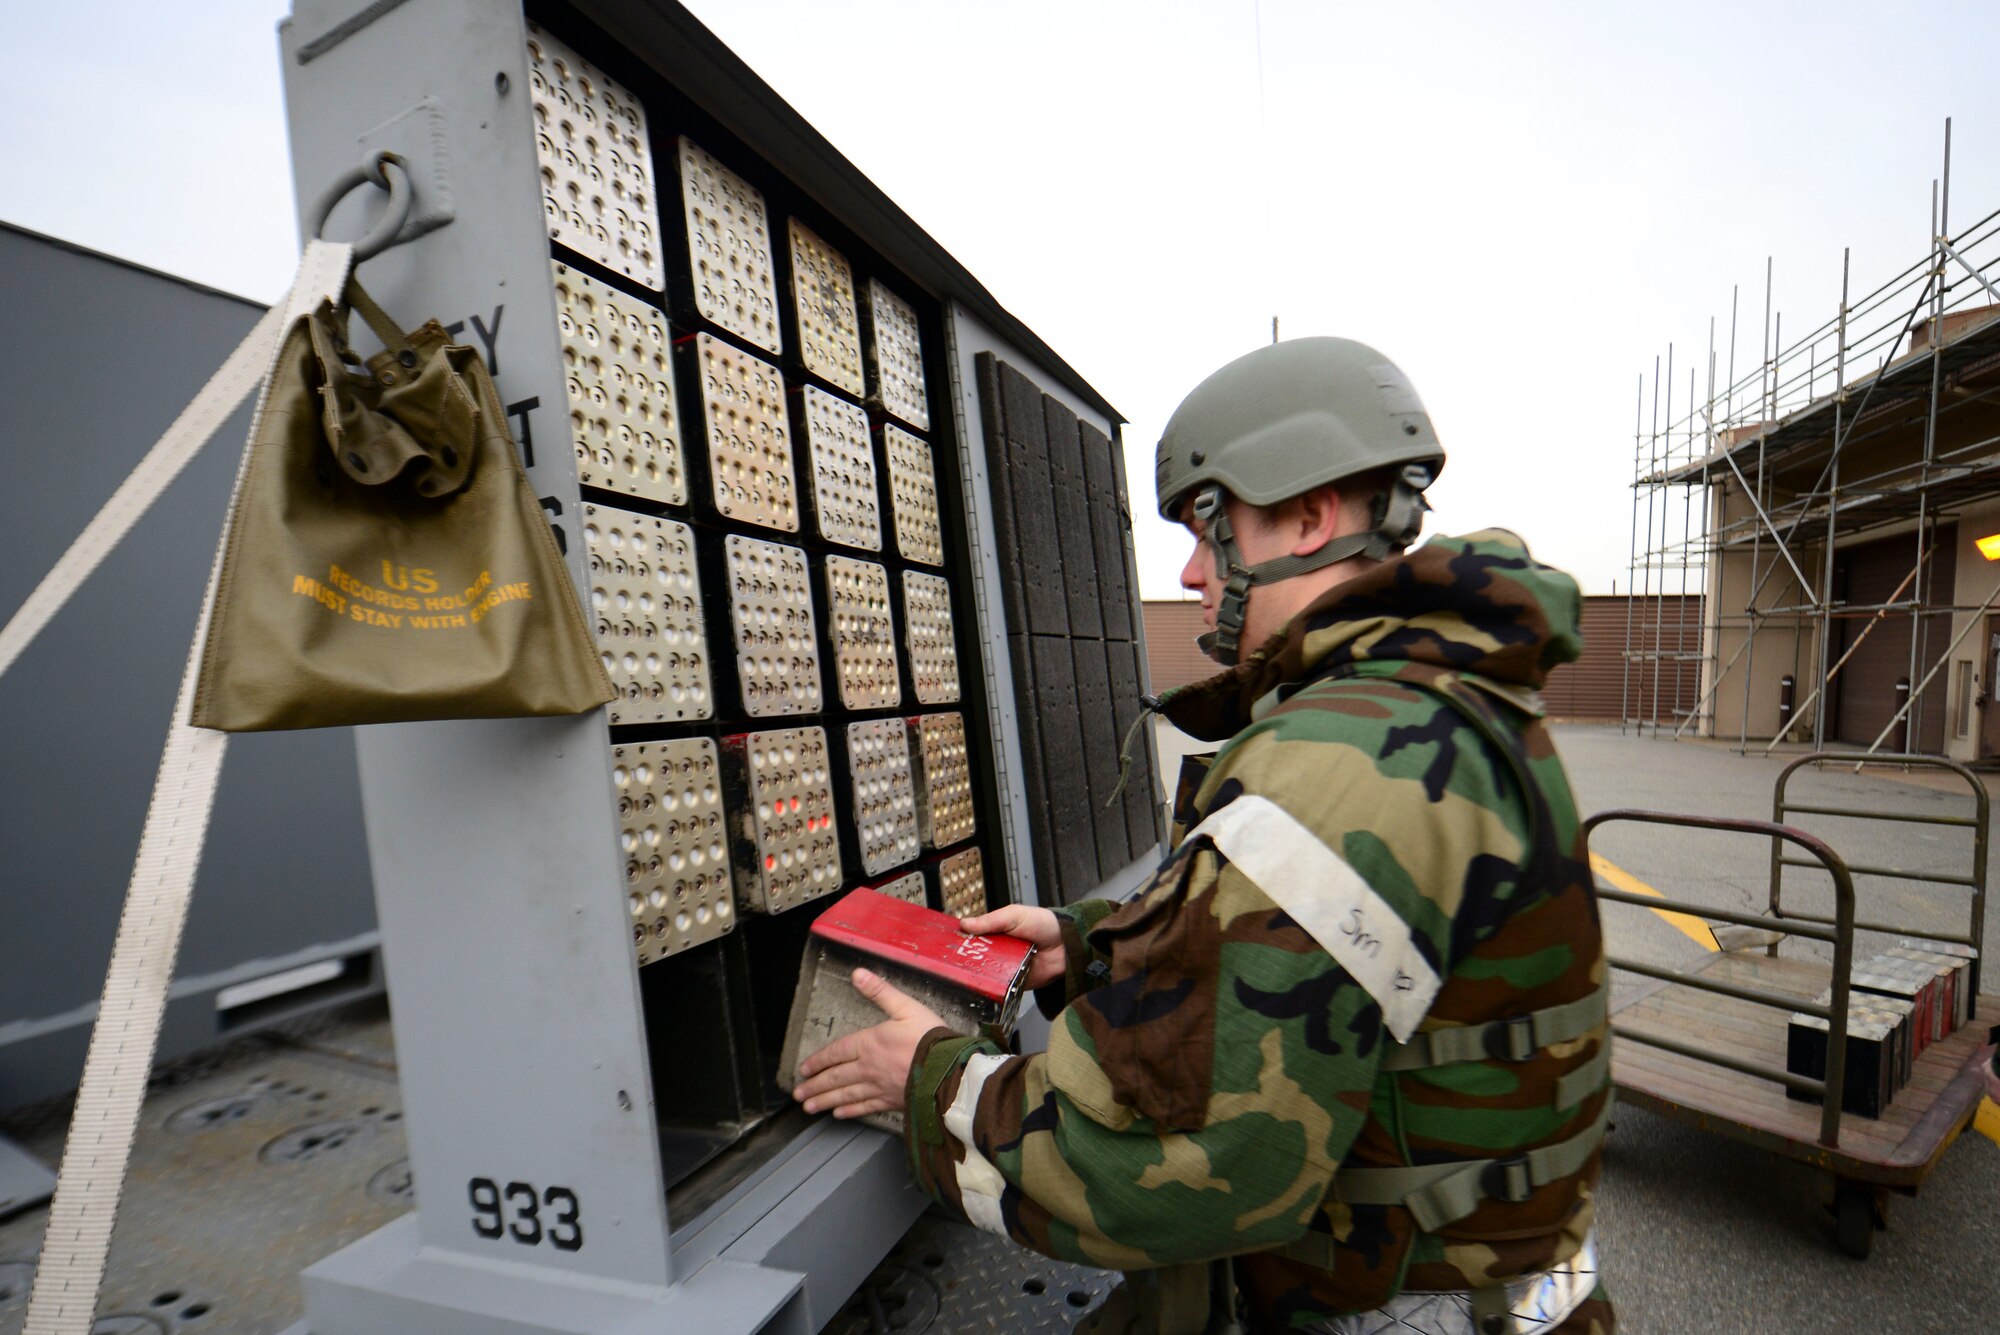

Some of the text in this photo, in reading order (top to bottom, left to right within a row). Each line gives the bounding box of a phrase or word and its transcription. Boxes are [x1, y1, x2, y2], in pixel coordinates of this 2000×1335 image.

[329, 564, 492, 611] RECORDS HOLDER
[382, 559, 439, 593] US
[293, 575, 532, 629] MUST STAY WITH ENGINE
[468, 1177, 583, 1252] 933
